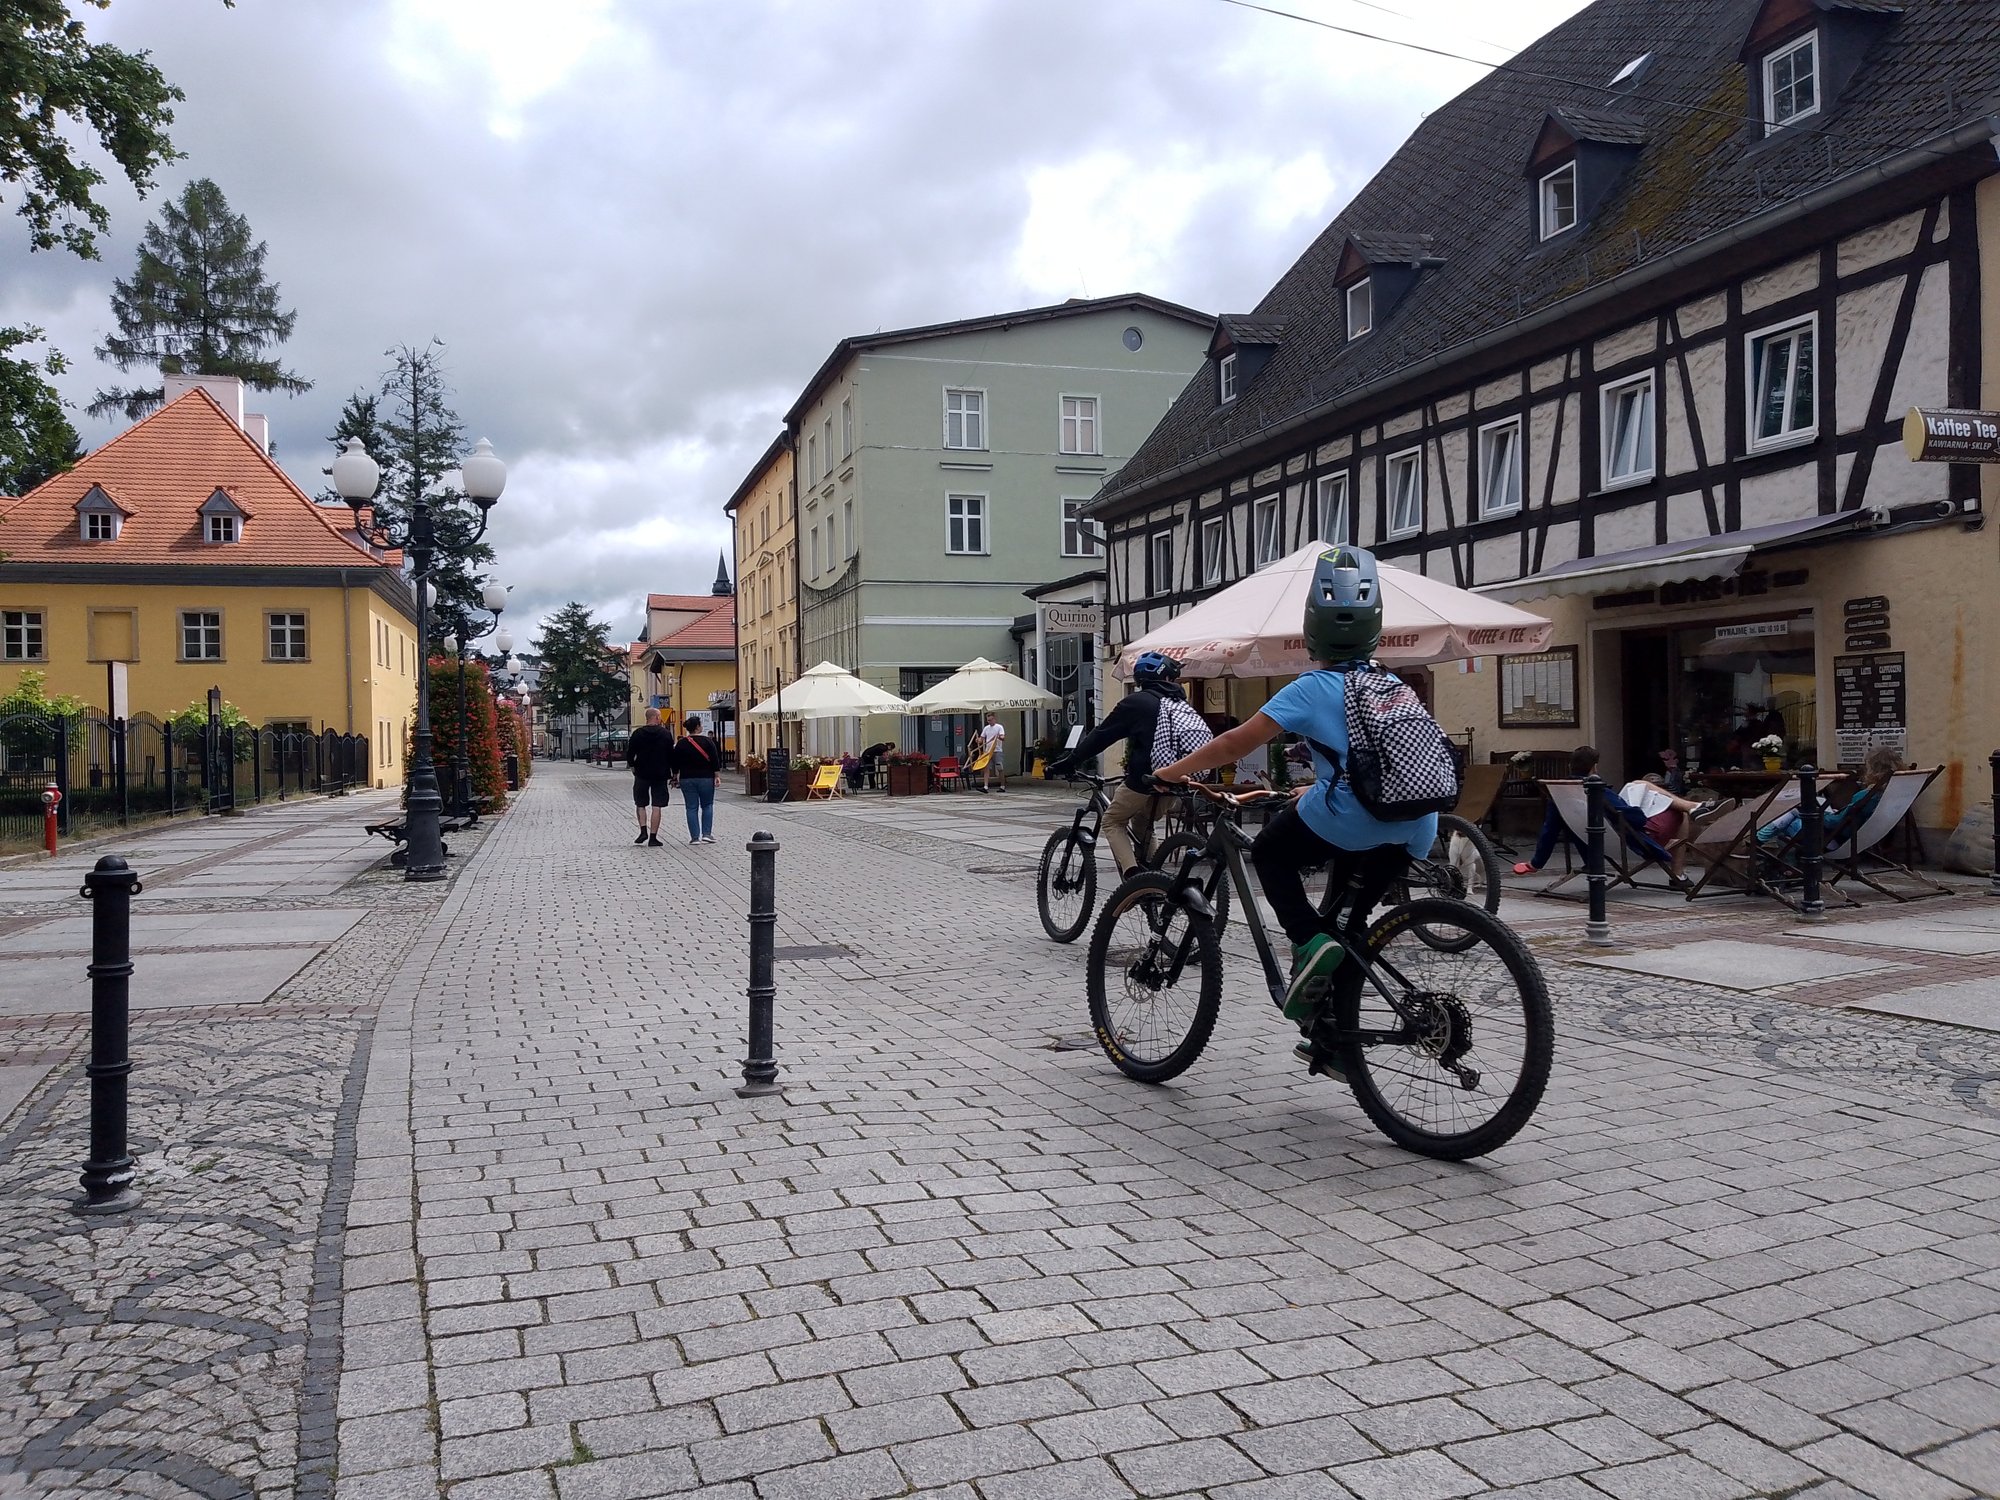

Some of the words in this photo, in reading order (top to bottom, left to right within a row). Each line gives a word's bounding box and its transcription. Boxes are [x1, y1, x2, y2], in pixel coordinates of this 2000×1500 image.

[1926, 417, 1971, 437] Kaffee
[1972, 419, 1998, 439] Tee
[1048, 608, 1097, 628] Quirino
[1378, 634, 1419, 647] SKLEP
[1467, 628, 1499, 645] KAFFEE
[1508, 627, 1527, 643] TEE
[1009, 699, 1037, 707] OKOCIM
[773, 711, 798, 721] OOCIM
[1367, 911, 1410, 947] MAXXIS
[1097, 1026, 1126, 1062] MAXXIS
